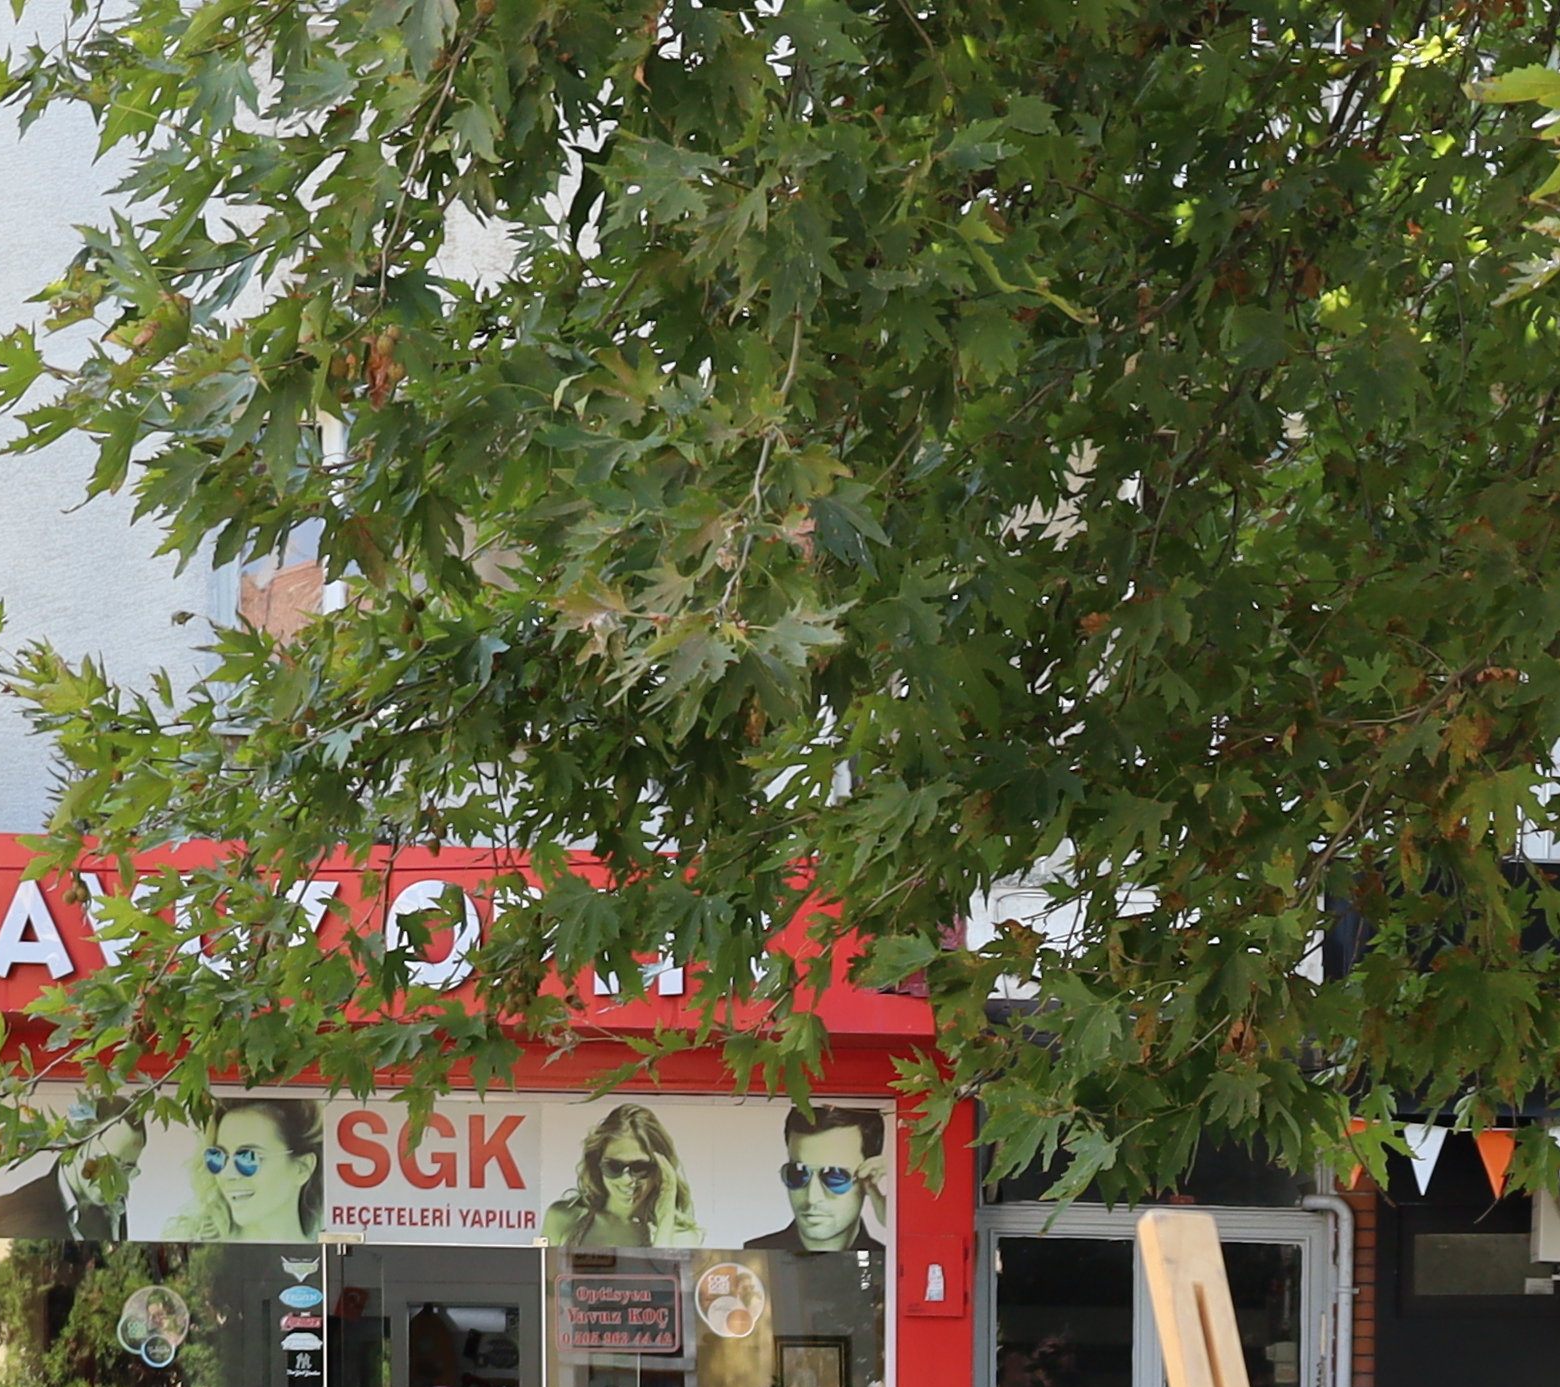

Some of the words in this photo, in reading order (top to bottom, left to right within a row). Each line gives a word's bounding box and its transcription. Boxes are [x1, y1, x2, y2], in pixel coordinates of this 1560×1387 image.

[336, 1110, 526, 1191] SGK
[332, 1204, 451, 1229] REÇETELERİ
[458, 1208, 536, 1231] YAPILIR
[576, 1286, 652, 1305] Optisyen
[567, 1307, 622, 1325] Yavuz
[627, 1308, 669, 1329] KOÇ
